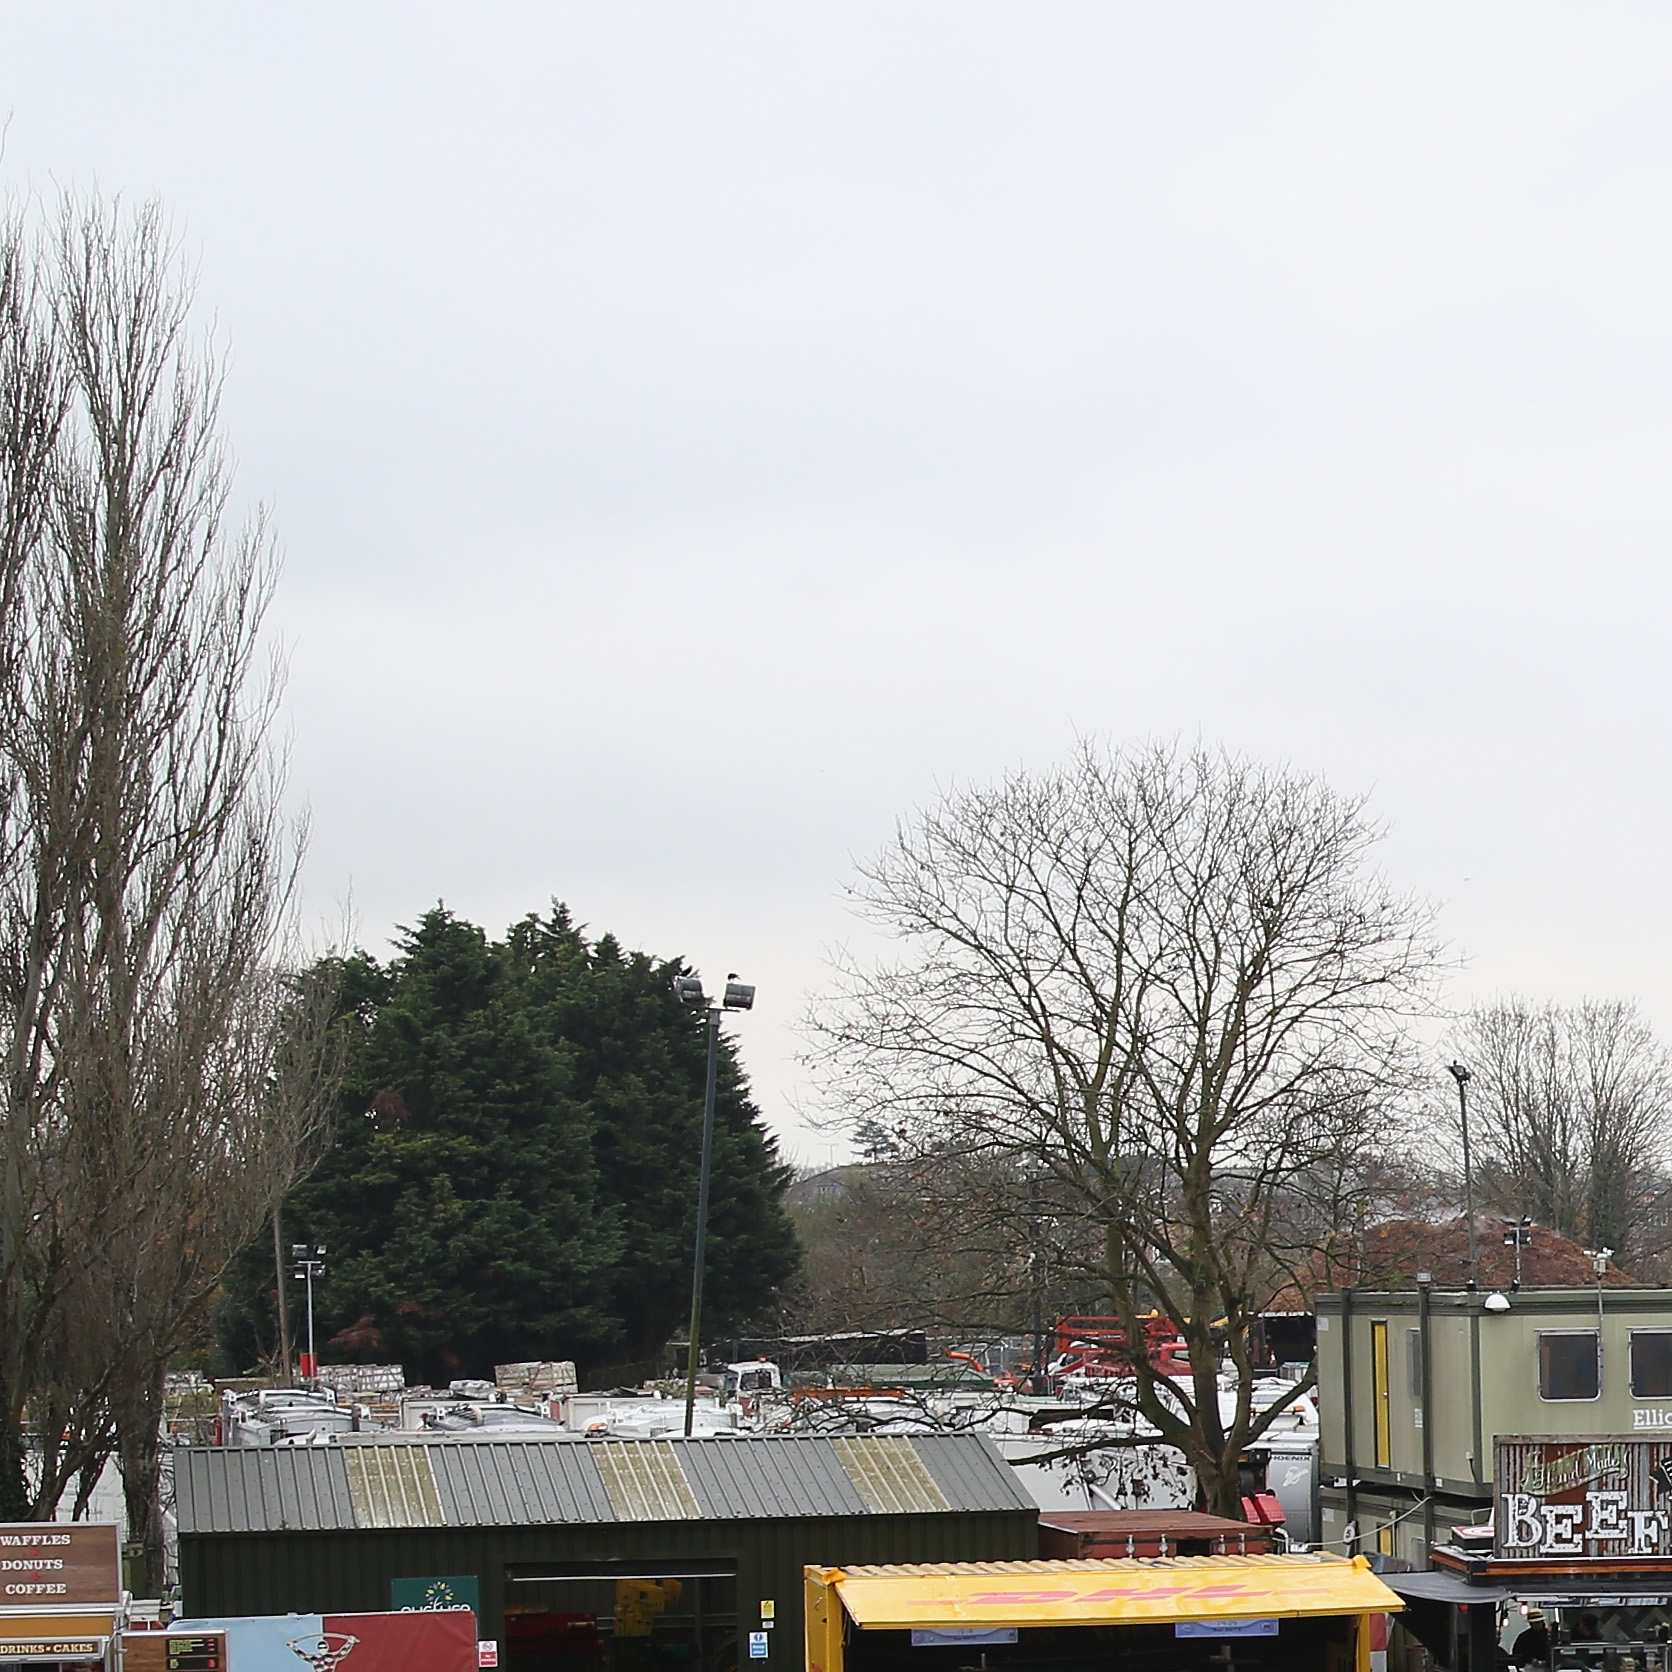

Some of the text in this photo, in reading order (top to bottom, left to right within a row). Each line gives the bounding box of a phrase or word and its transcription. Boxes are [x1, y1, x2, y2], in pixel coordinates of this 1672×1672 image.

[0, 1534, 71, 1546] WAFFLES
[1, 1559, 64, 1571] DONUTS
[5, 1583, 67, 1595] COFFEE
[968, 1584, 1272, 1605] DHL
[0, 1643, 93, 1654] DRINKS CAKES
